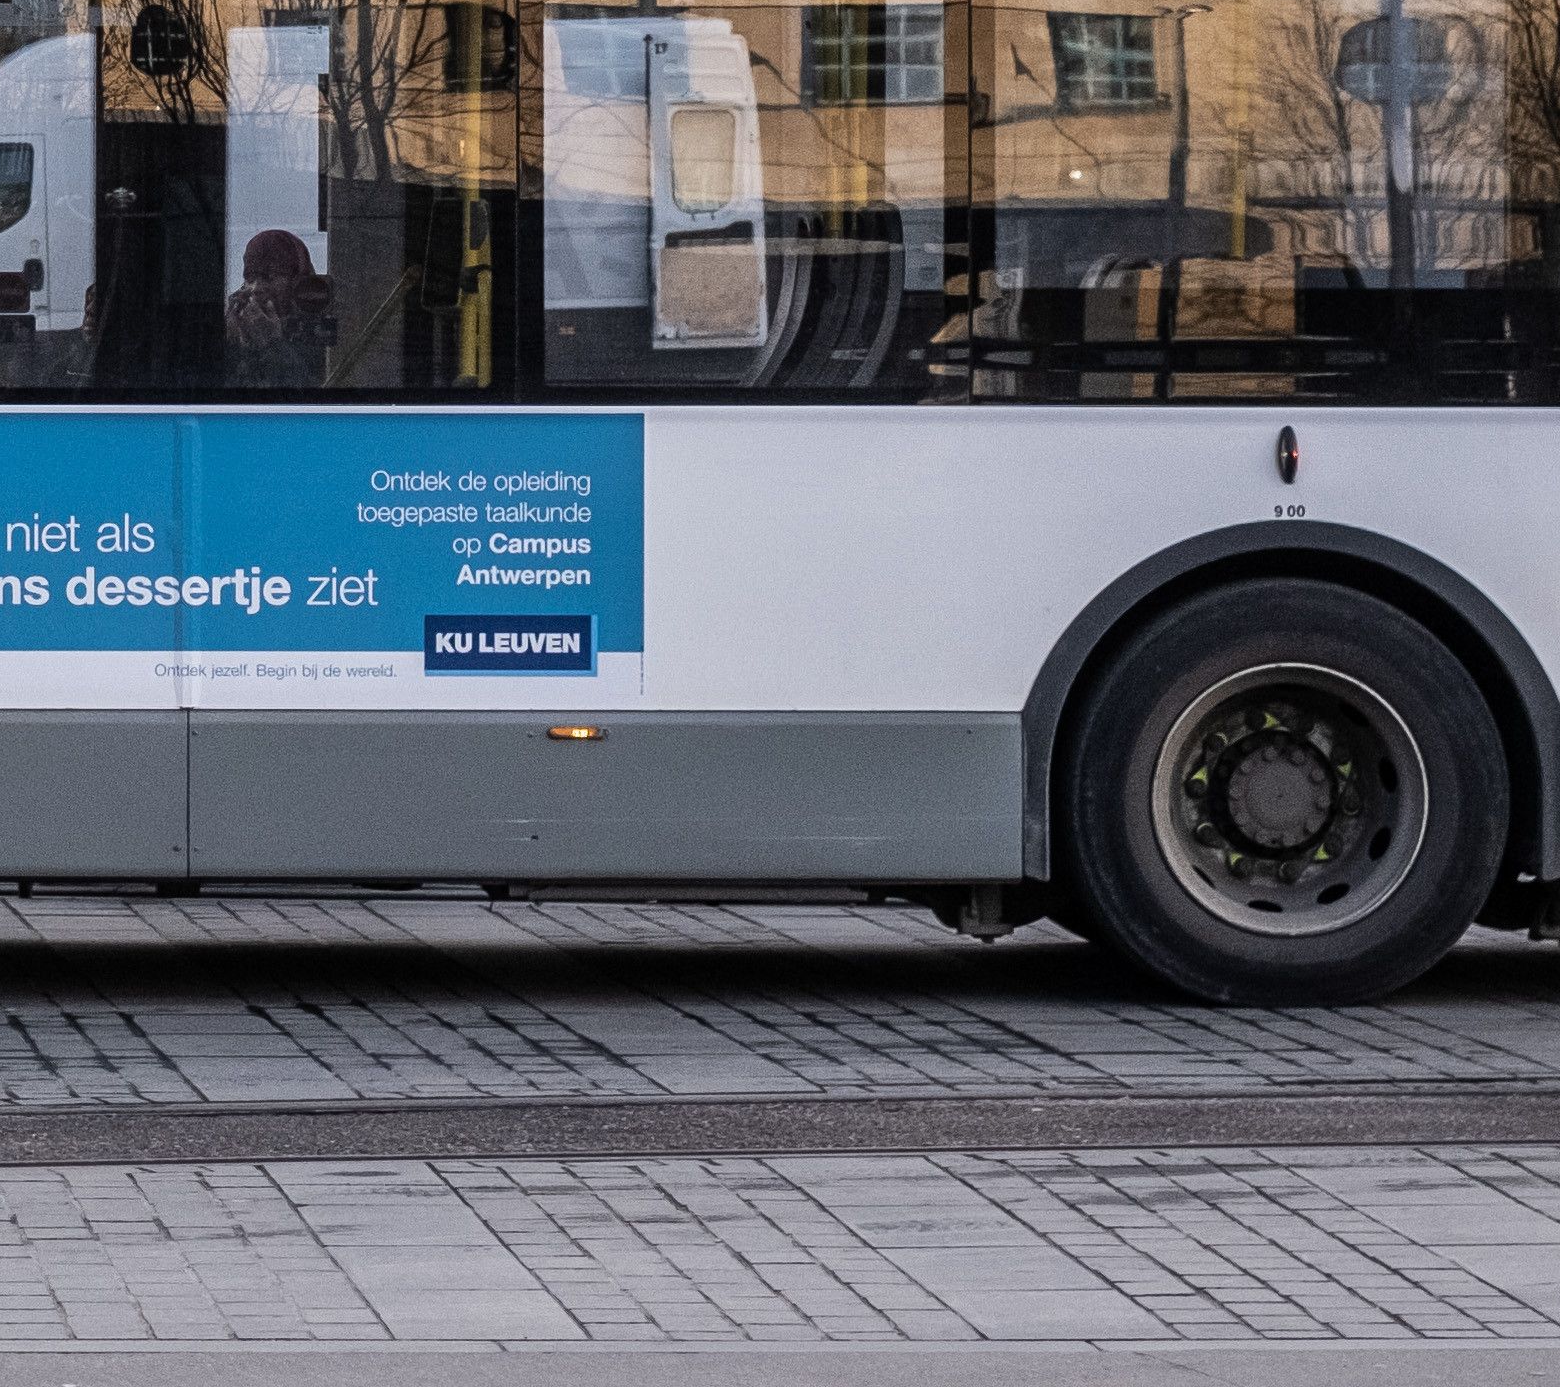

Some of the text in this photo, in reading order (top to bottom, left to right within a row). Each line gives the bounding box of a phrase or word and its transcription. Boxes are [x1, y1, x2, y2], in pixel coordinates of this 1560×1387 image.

[370, 469, 591, 498] Ontdek de opleiding
[357, 501, 592, 527] toegepaste taalkunde
[6, 513, 81, 553] niet
[95, 513, 155, 553] als
[452, 532, 591, 560] op Campus
[65, 566, 292, 616] dessertje
[306, 567, 379, 607] ziet
[456, 564, 591, 591] Antwerpen
[435, 631, 580, 655] KU LEUVEN
[153, 663, 398, 681] Ontdek jezelf. Begin bij de wereld.
